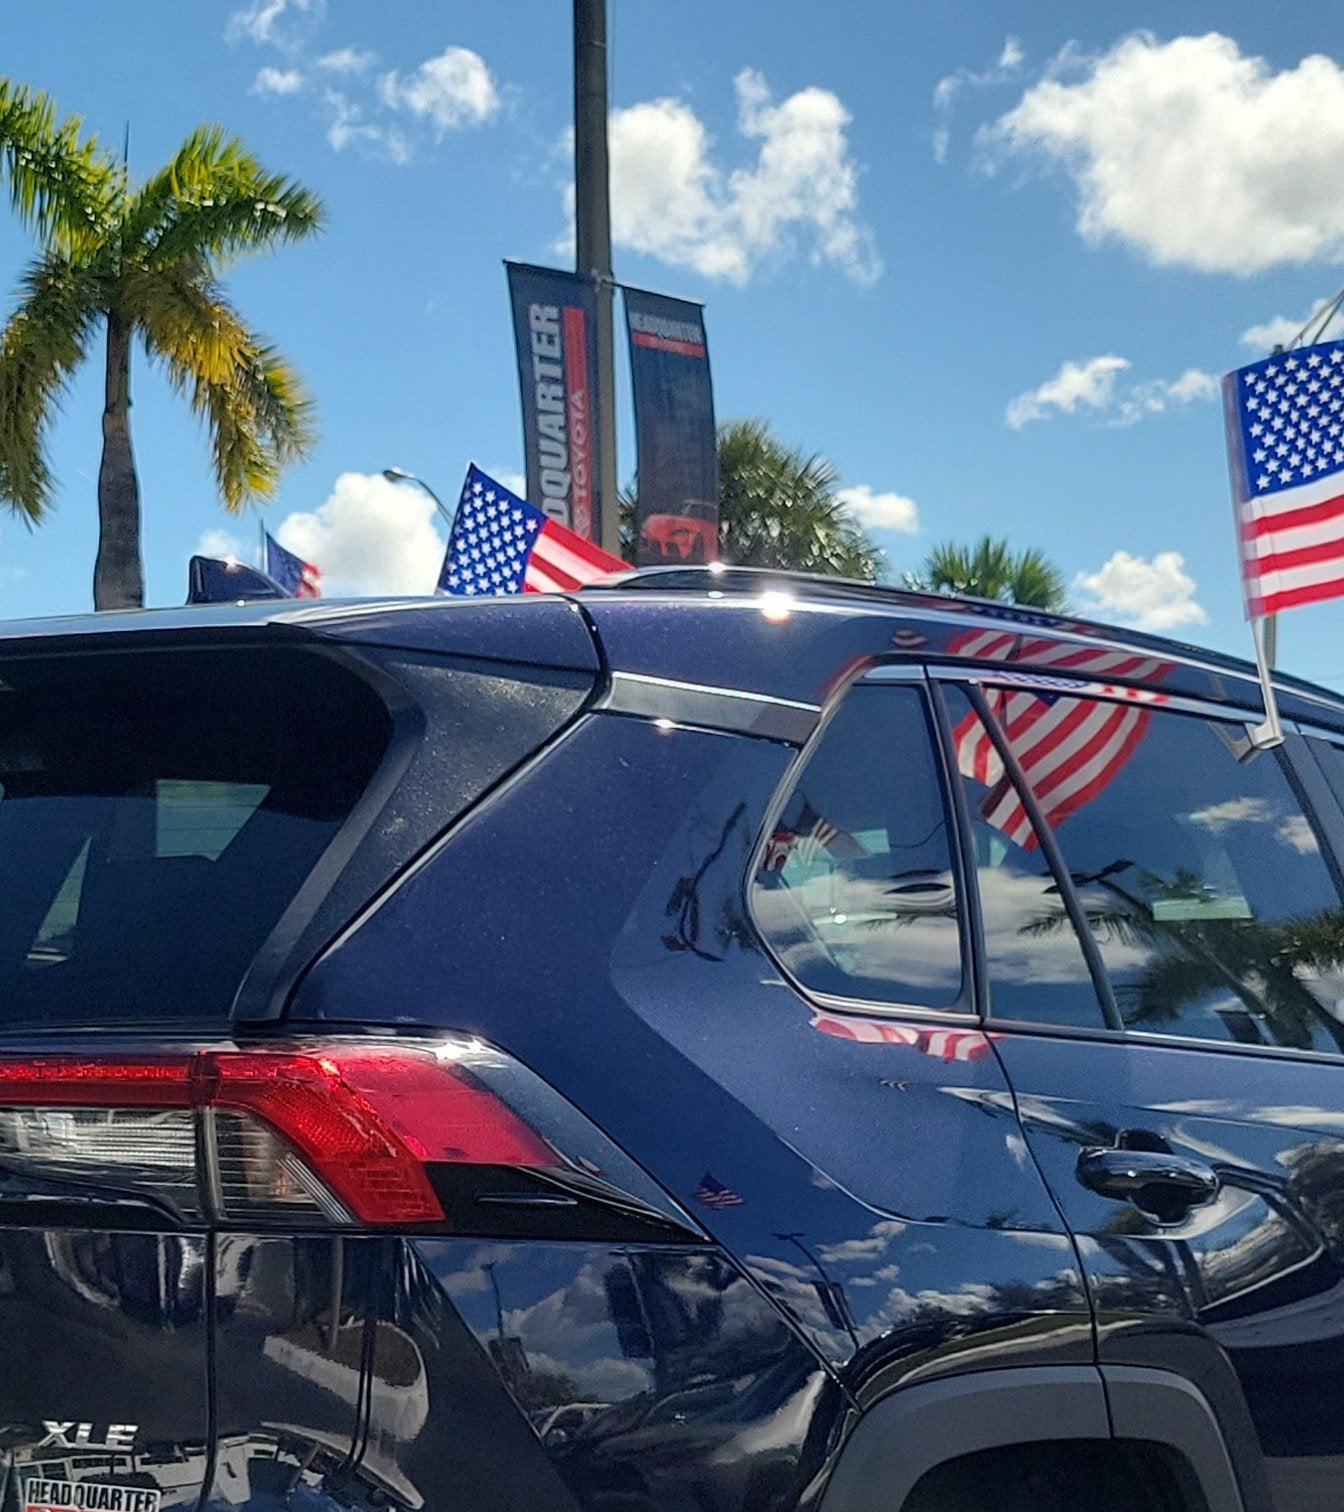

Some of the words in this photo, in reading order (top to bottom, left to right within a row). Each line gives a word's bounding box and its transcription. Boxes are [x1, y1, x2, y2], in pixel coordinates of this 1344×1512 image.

[529, 303, 571, 526] DQUARTER
[569, 392, 592, 501] TOYOTA
[36, 1420, 139, 1451] XLE
